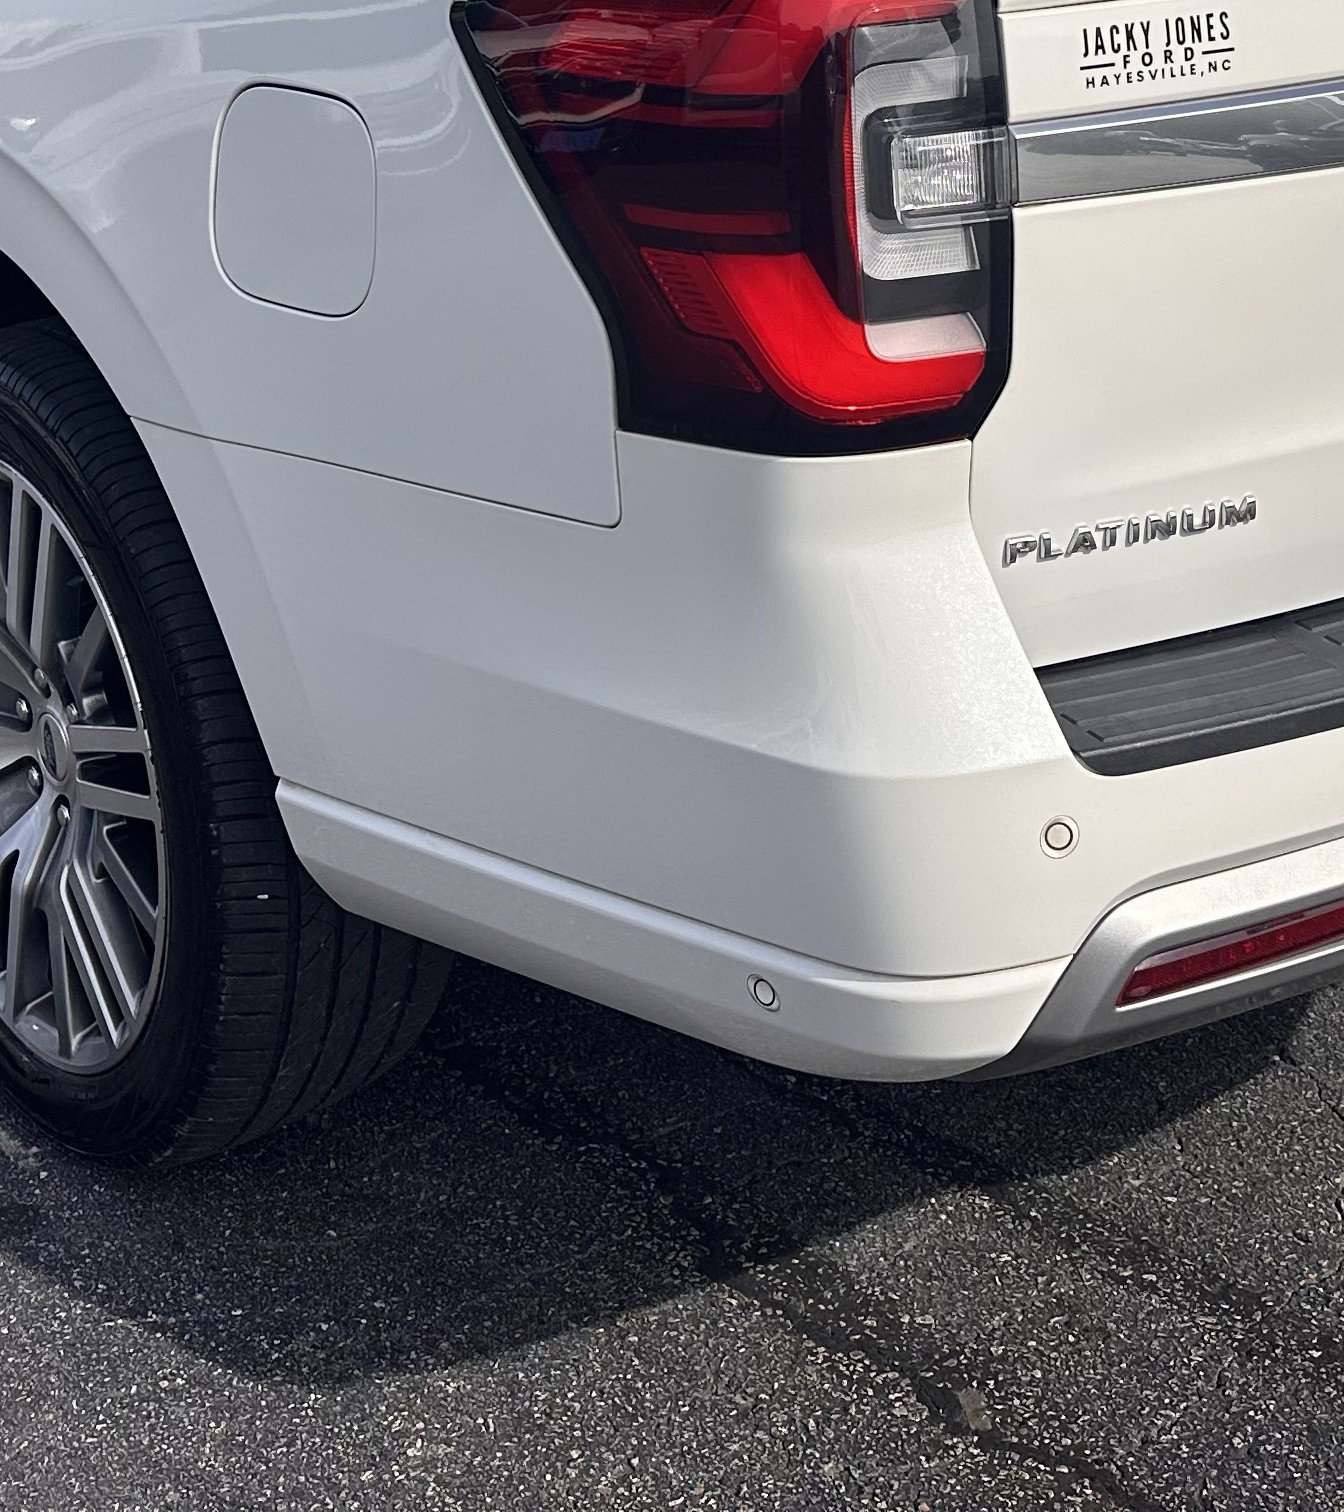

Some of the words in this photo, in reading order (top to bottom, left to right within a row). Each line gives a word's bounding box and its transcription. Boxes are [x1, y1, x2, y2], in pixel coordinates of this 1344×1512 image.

[1082, 20, 1151, 58] JACKY
[1164, 11, 1231, 48] JONES
[1122, 46, 1195, 70] FORD
[1002, 494, 1257, 569] PLATINUM
